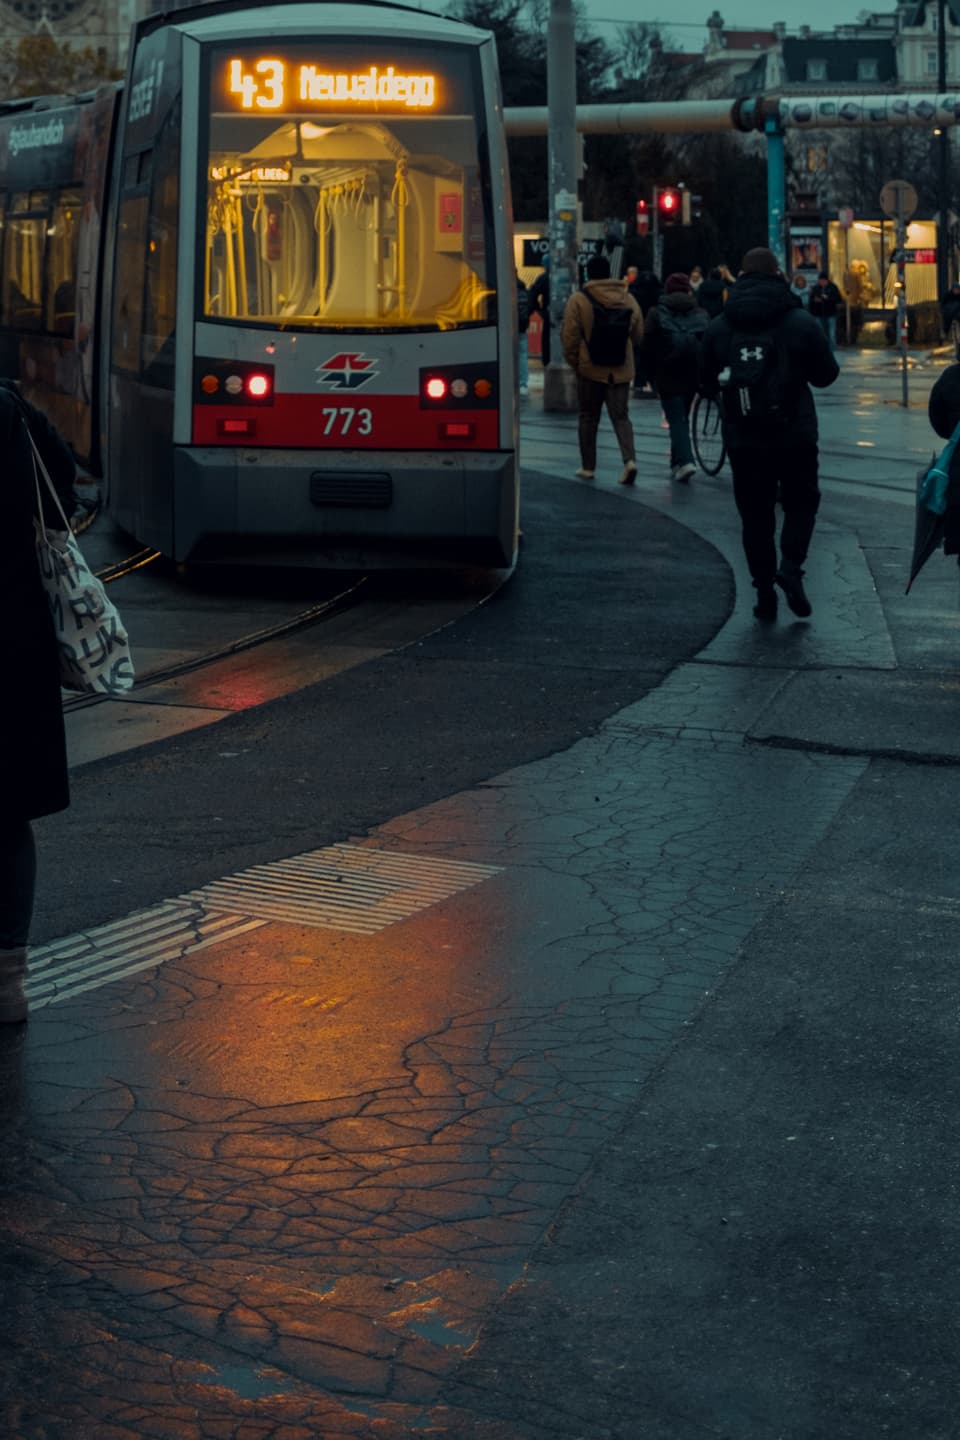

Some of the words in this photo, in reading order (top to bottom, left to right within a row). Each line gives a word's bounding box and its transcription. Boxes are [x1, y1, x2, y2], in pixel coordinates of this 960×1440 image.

[230, 59, 284, 108] 43
[300, 66, 435, 107] Neuwaldegg
[322, 408, 373, 435] 773
